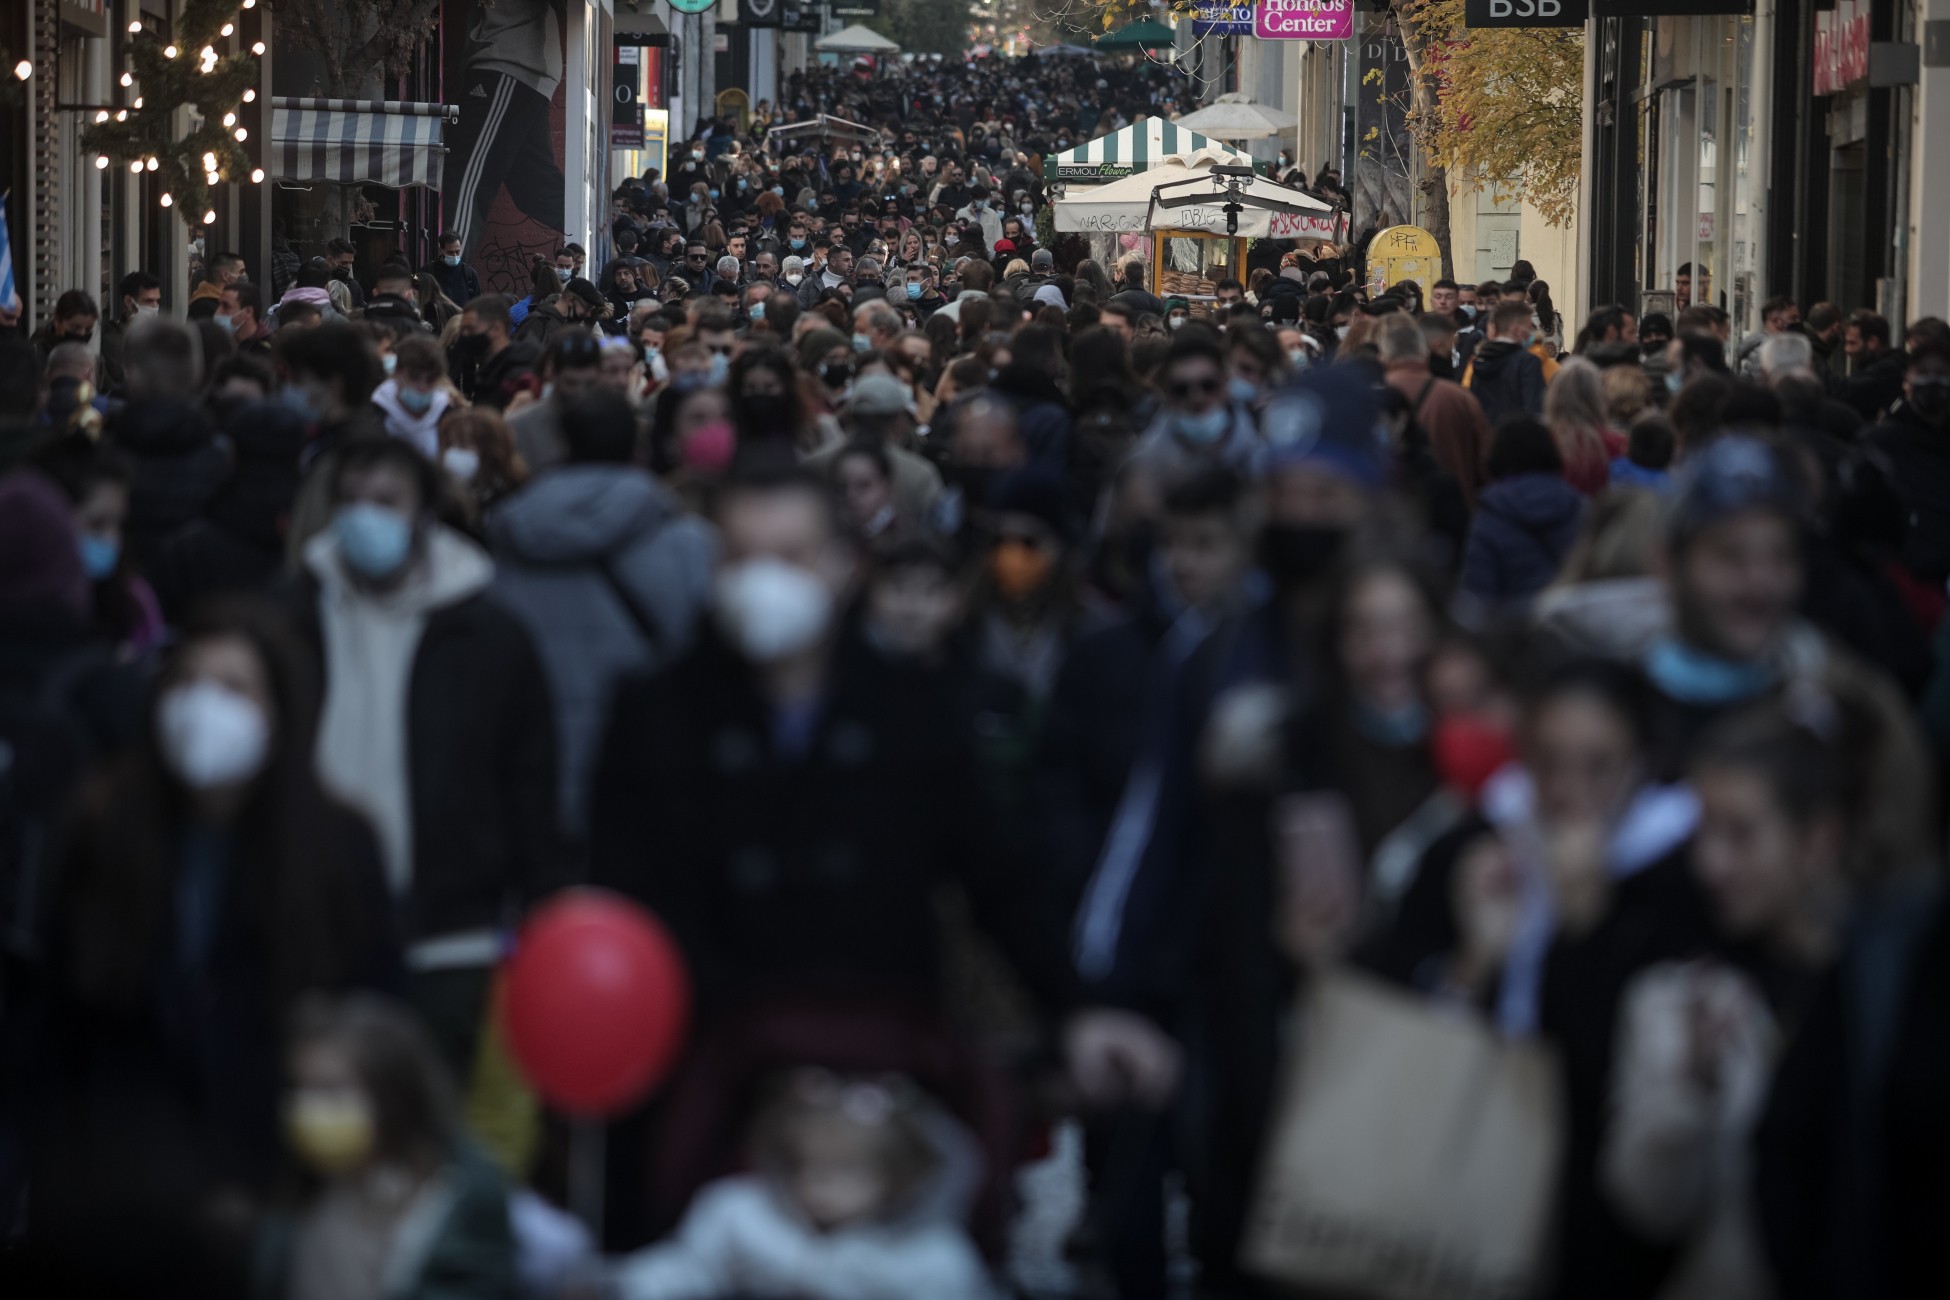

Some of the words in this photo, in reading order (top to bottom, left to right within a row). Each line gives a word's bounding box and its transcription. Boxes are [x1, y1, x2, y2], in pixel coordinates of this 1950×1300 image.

[1264, 11, 1336, 32] Center
[1058, 167, 1097, 176] ERMOU
[1098, 163, 1131, 176] Flower
